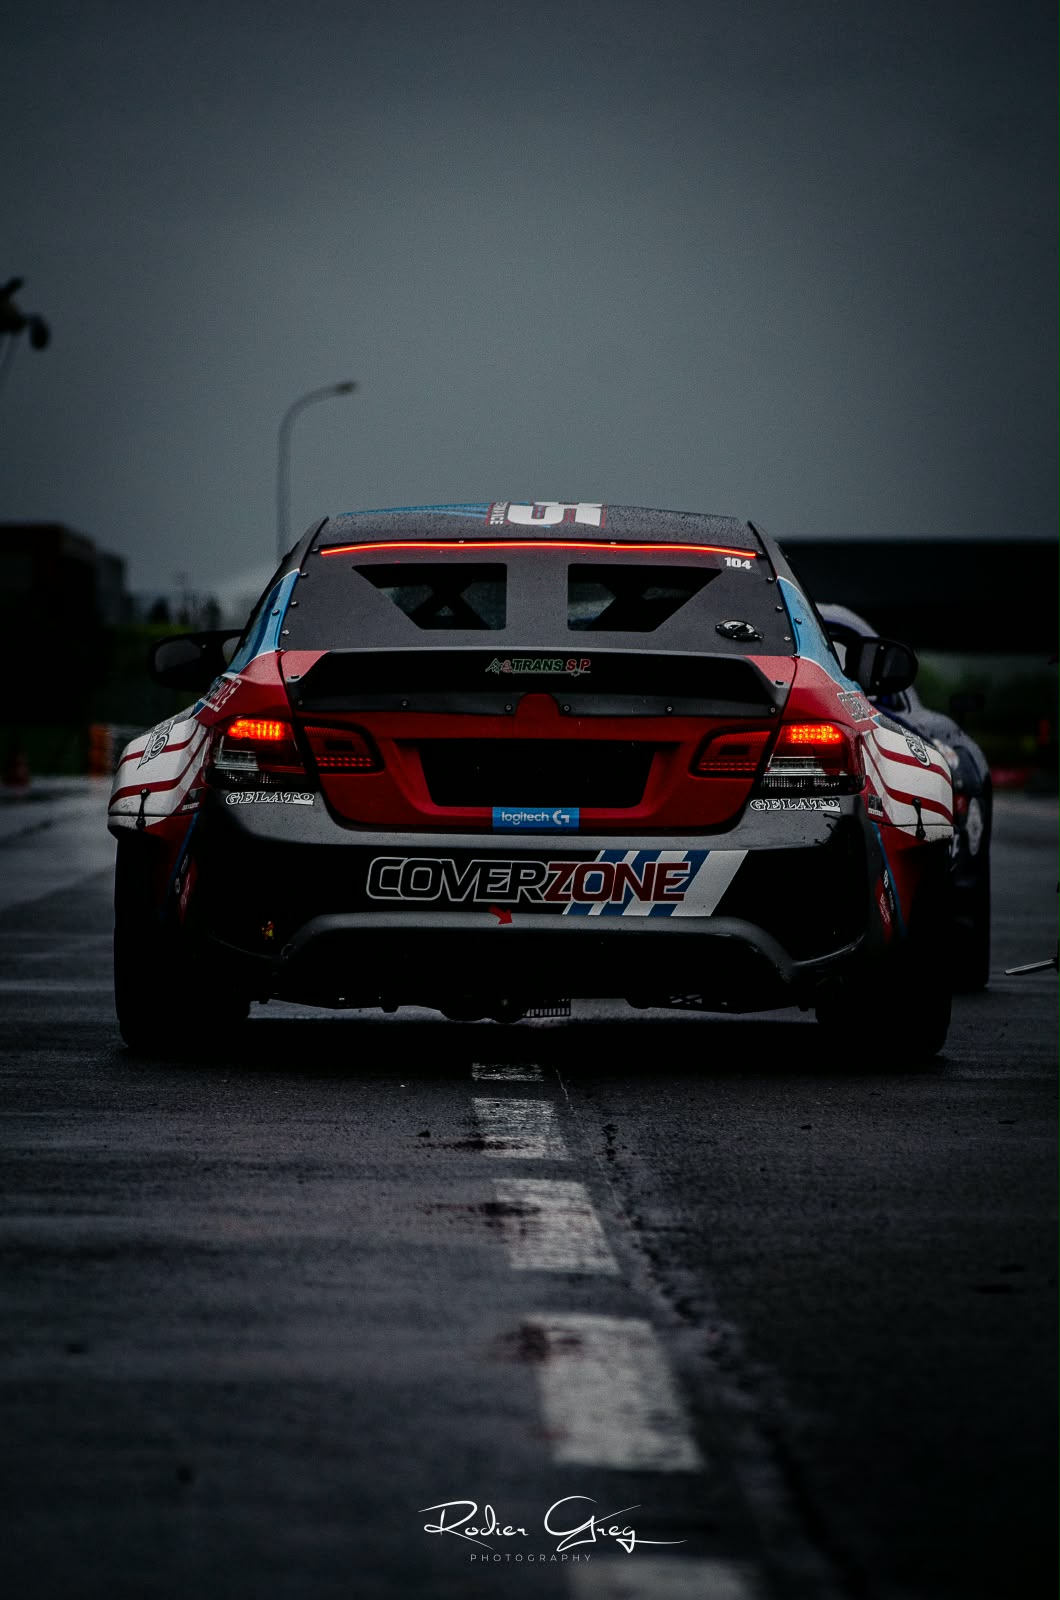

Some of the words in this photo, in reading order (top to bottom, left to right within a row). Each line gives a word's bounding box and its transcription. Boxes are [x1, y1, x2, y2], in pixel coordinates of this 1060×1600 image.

[723, 556, 753, 570] 104
[512, 658, 563, 672] TRANS
[225, 791, 315, 806] GELATO
[749, 798, 841, 813] GELATO
[501, 811, 550, 825] logitech
[366, 856, 693, 904] COVERZONE
